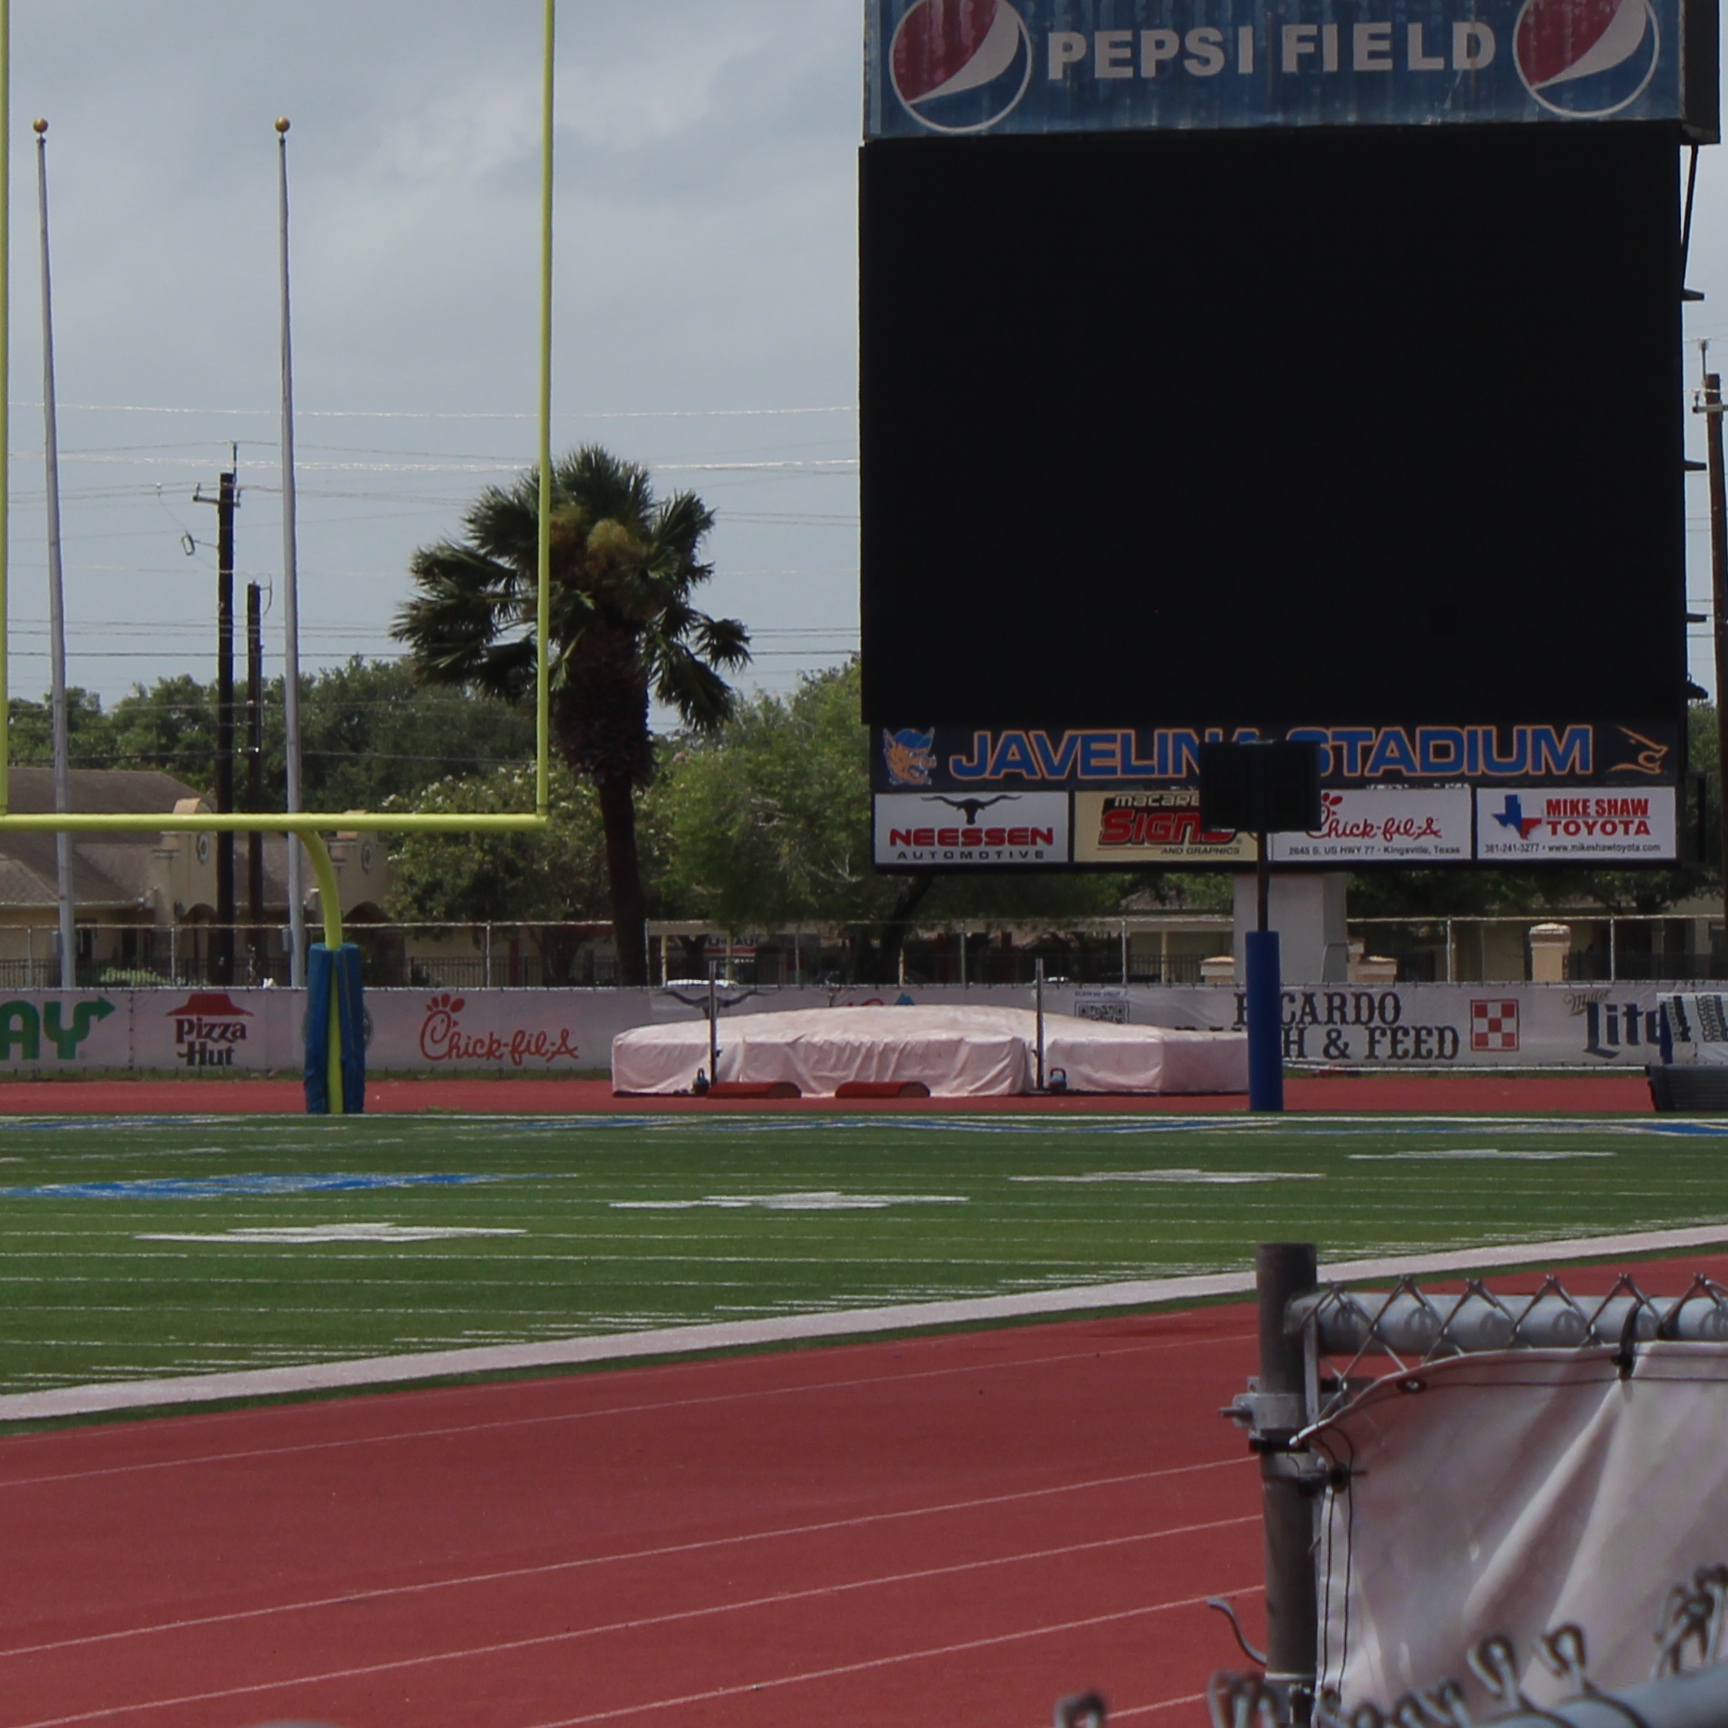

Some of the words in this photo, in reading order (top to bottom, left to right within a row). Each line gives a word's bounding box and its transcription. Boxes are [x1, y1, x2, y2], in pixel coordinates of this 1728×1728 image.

[1048, 27, 1253, 80] PEPSI
[1281, 22, 1496, 75] FIELD
[950, 727, 1262, 781] JAVELIN
[1545, 798, 1591, 817] MIKE
[1594, 798, 1650, 816] SHAW
[889, 827, 1054, 847] NEESSEN
[1546, 819, 1652, 837] TOYOTA
[897, 850, 1045, 860] AUTOMOTIVE
[1160, 847, 1184, 855] AND
[1186, 846, 1240, 855] GRAPHICS
[1324, 846, 1338, 854] US
[1340, 846, 1362, 854] HWY
[1364, 846, 1376, 854] 77
[1434, 845, 1461, 854] Texas
[1234, 992, 1401, 1025] CARDO
[175, 1017, 248, 1045] Pizza
[1364, 1025, 1460, 1060] FEED
[176, 1040, 235, 1066] Hut
